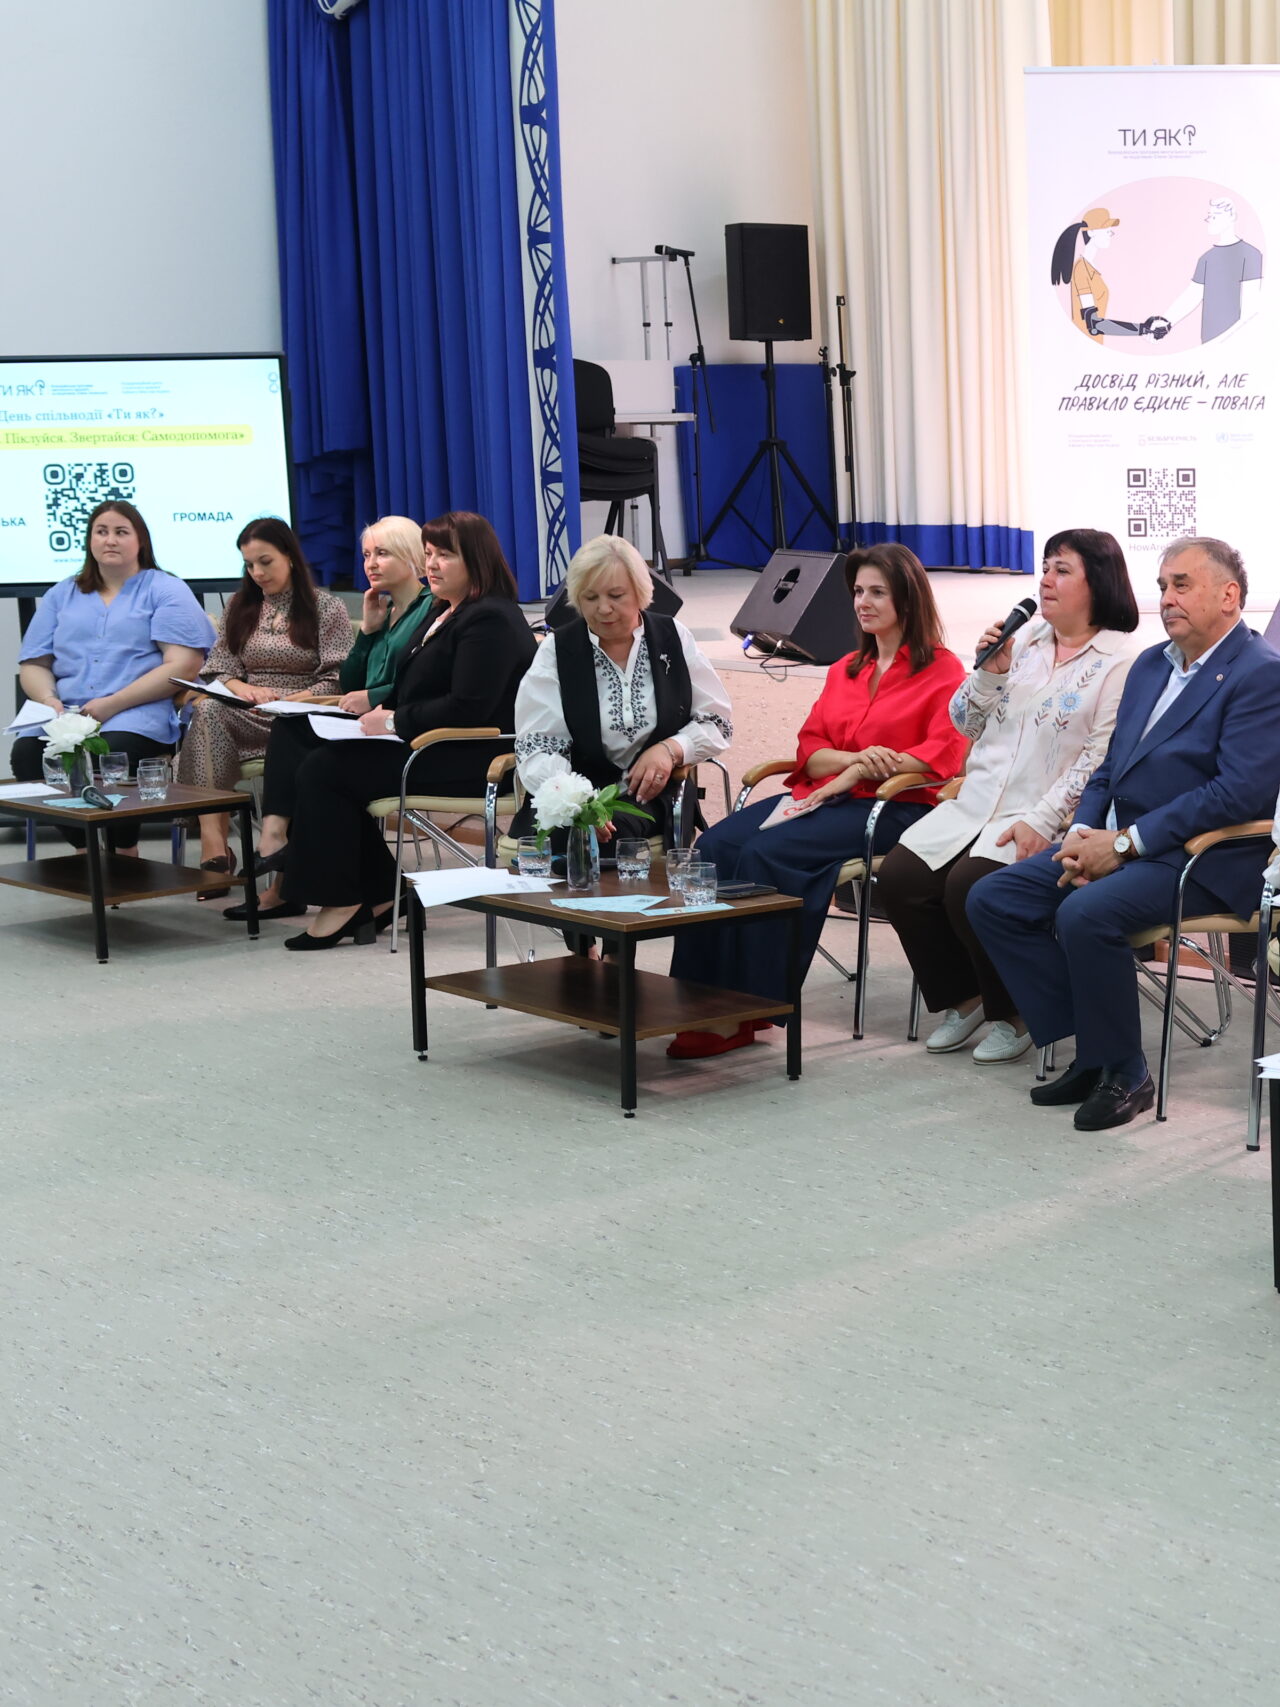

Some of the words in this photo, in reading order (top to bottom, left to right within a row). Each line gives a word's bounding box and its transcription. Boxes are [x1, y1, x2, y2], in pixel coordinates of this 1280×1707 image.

[1117, 128, 1147, 146] ТИ
[1217, 373, 1249, 388] АЛЕ
[1058, 396, 1129, 411] ПРАВИЛО
[1134, 395, 1193, 413] ЄДИНЕ
[1211, 395, 1266, 411] ПОВАГА
[35, 409, 104, 421] спільнодії
[173, 511, 234, 522] ГРОМАДА
